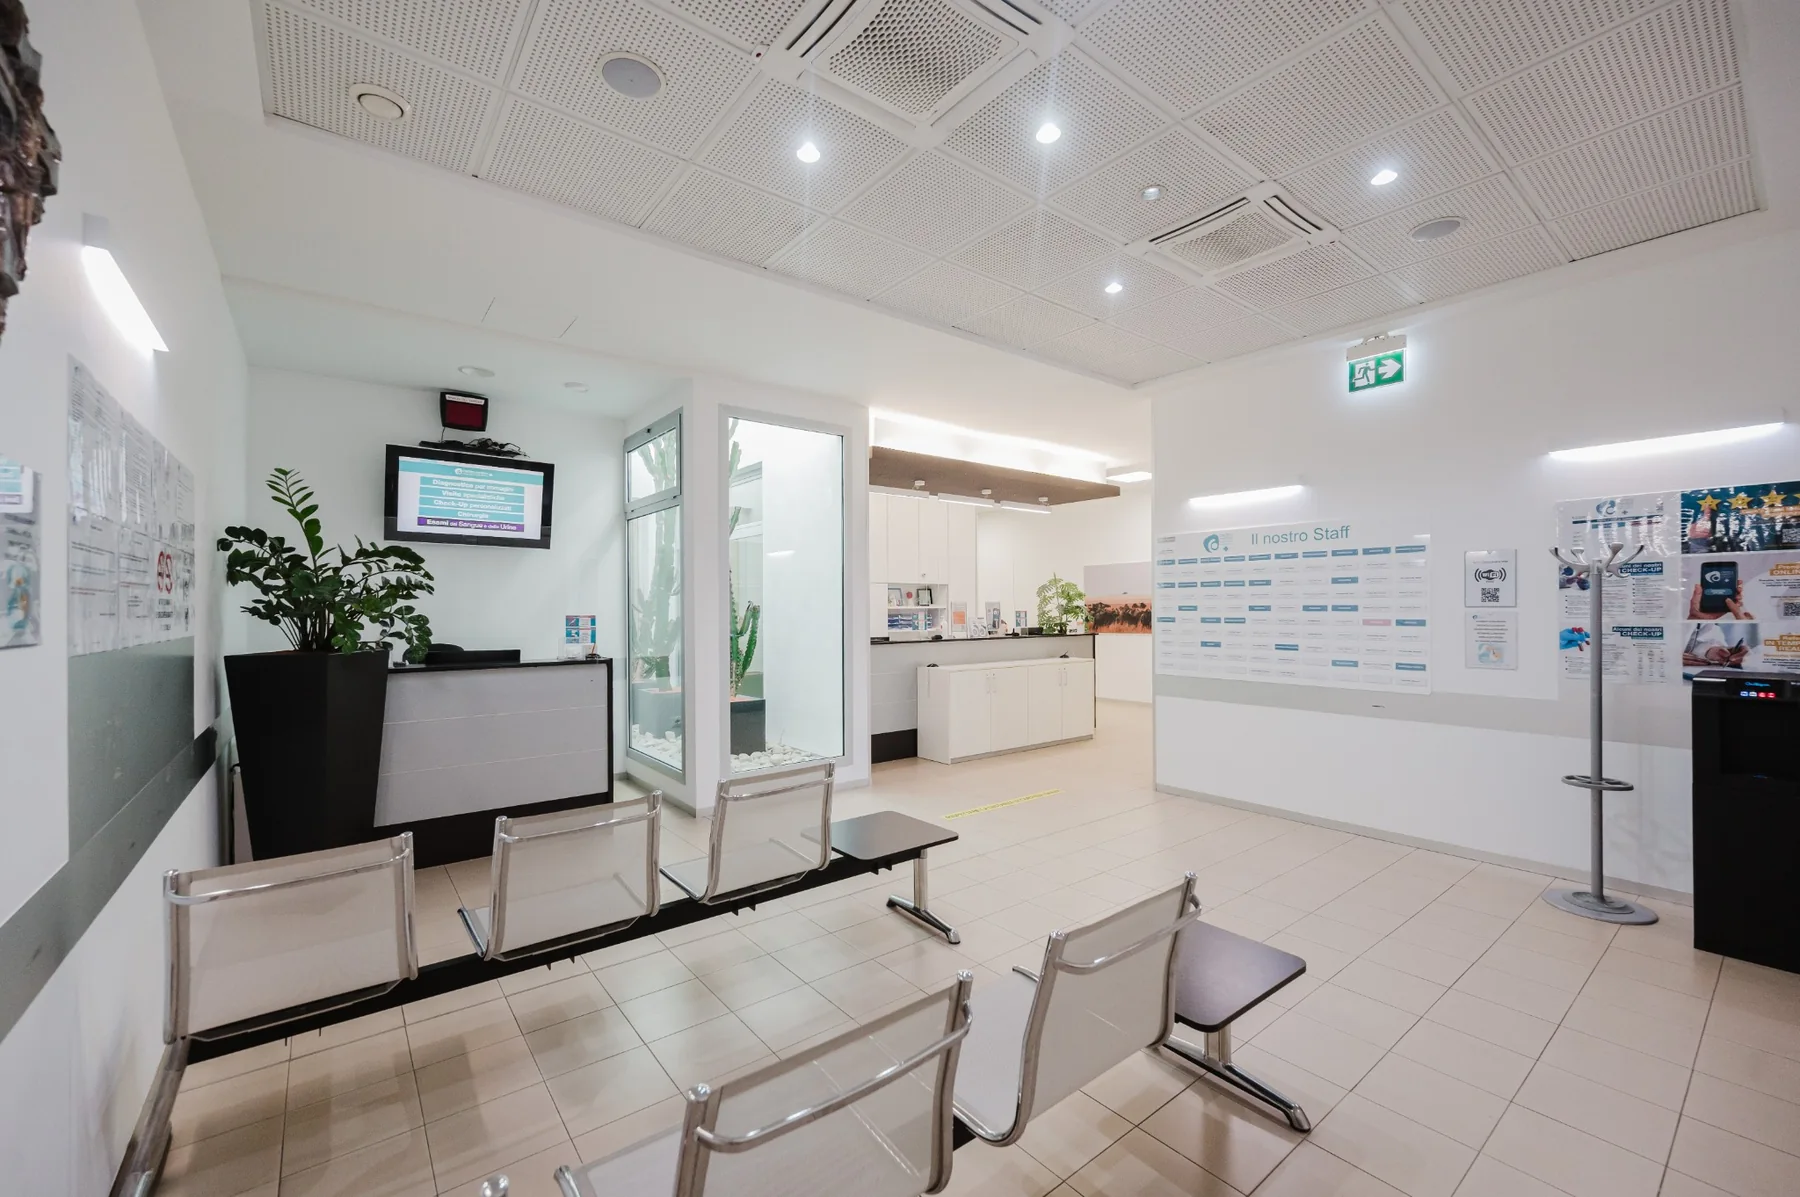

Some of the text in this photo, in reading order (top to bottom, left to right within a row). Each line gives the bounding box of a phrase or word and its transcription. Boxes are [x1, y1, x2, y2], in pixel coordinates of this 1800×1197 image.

[432, 479, 474, 489] Diagnostica
[442, 490, 462, 498] Visite
[434, 499, 468, 509] Check-Up
[457, 511, 489, 520] Chirurgia
[426, 518, 449, 526] Esami
[458, 521, 484, 530] Sangue
[1251, 525, 1350, 545] Il nostro Staff
